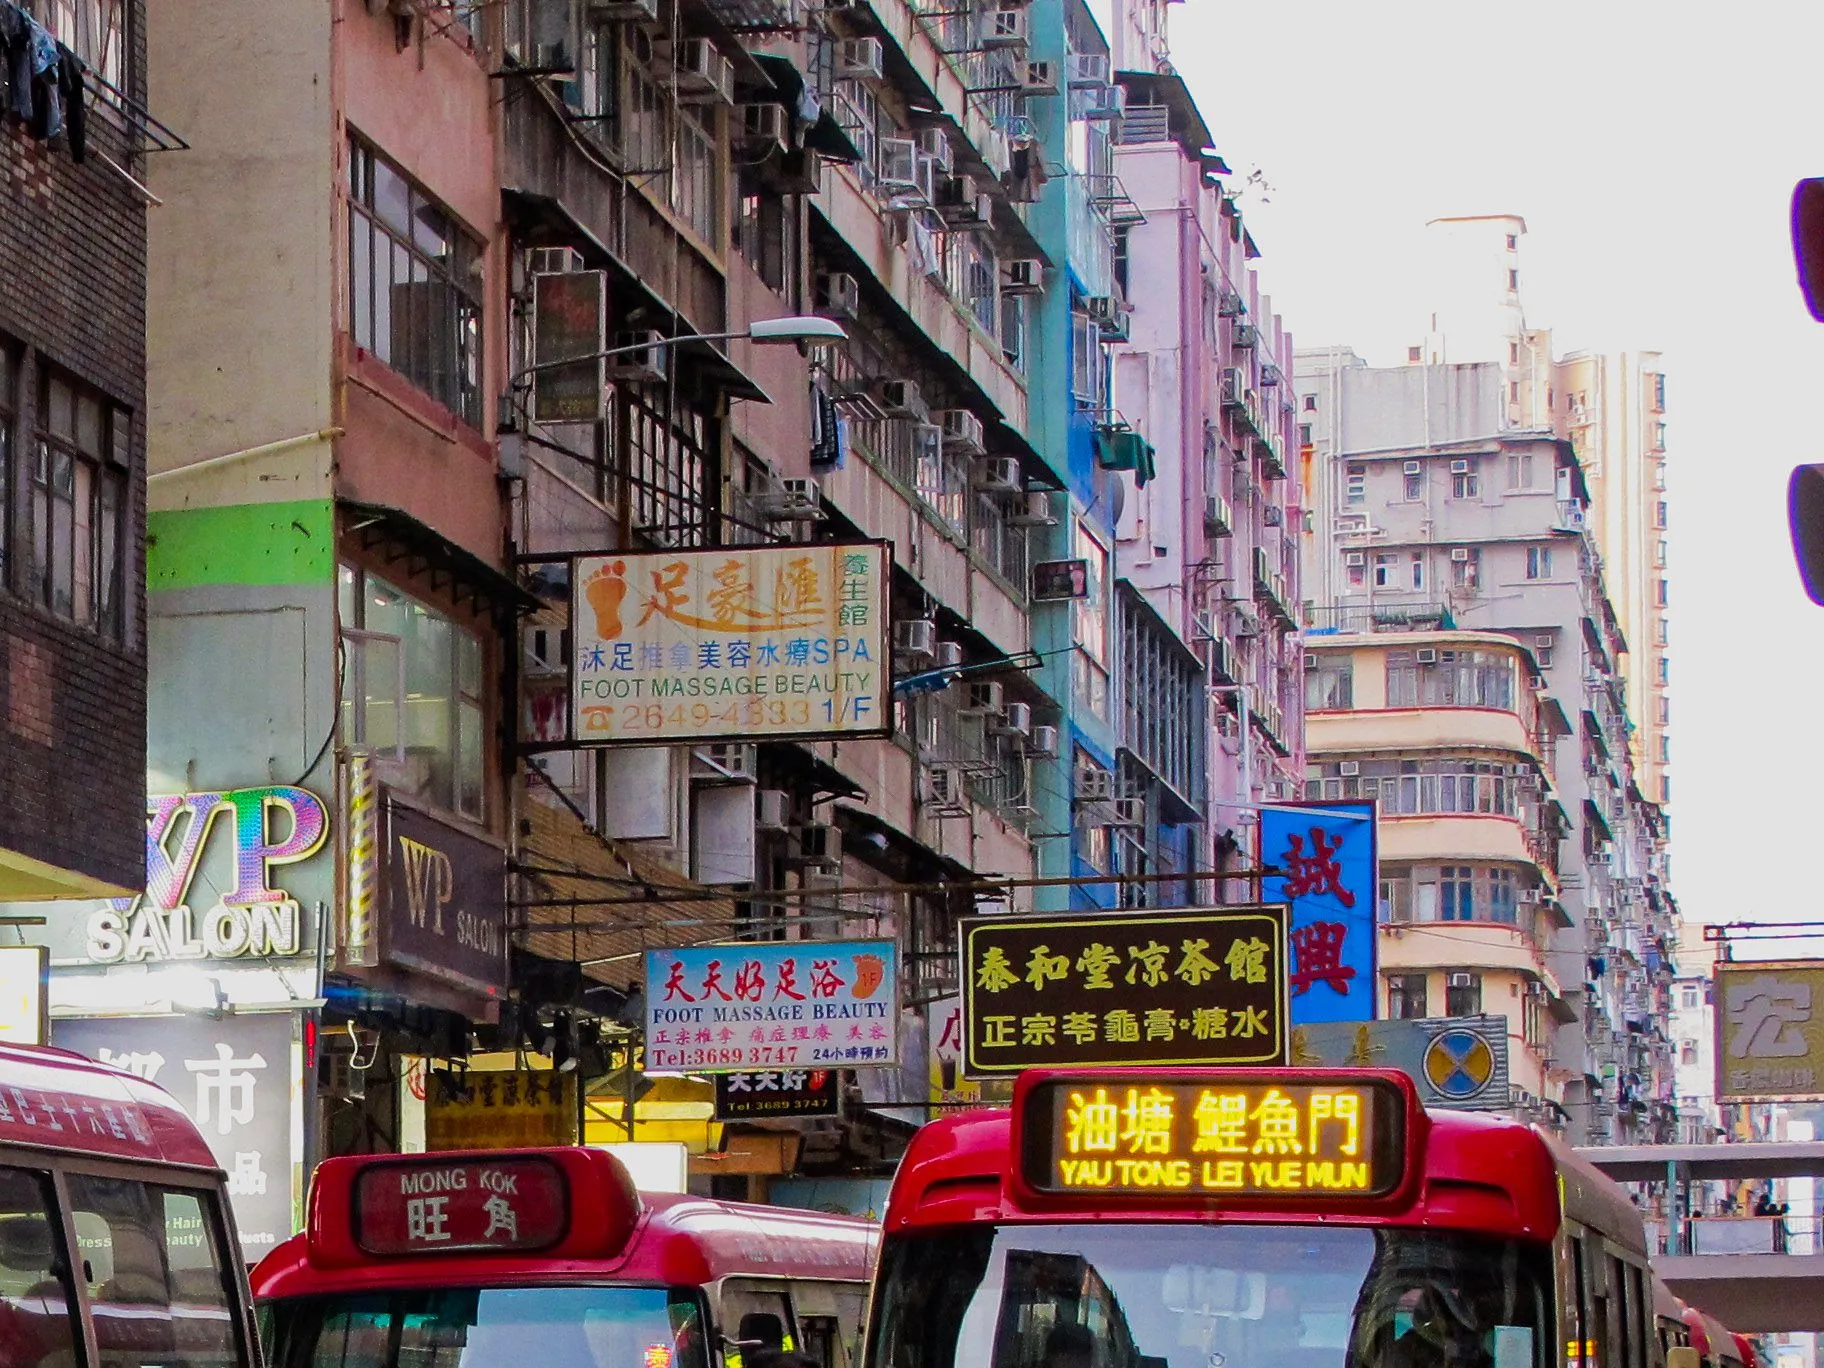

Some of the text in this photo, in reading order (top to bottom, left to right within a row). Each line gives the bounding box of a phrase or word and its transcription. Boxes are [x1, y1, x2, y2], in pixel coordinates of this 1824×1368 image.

[581, 671, 871, 699] FOOT MASSAGE BEAUTY
[821, 696, 873, 724] 1/F
[398, 834, 454, 937] WP
[87, 902, 300, 964] SALON
[456, 913, 499, 958] SALON
[662, 957, 846, 1002] 天天好足浴
[652, 1001, 889, 1024] FOOT MASSAGE BEAUTY
[846, 1022, 889, 1040] 美容
[749, 1046, 799, 1063] 3747
[1065, 1087, 1359, 1155] 油塘 鯉魚門
[400, 1168, 518, 1196] MONG KOK
[1058, 1159, 1368, 1188] YAU TONG LEI YUE MUN
[407, 1196, 519, 1242] 旺角
